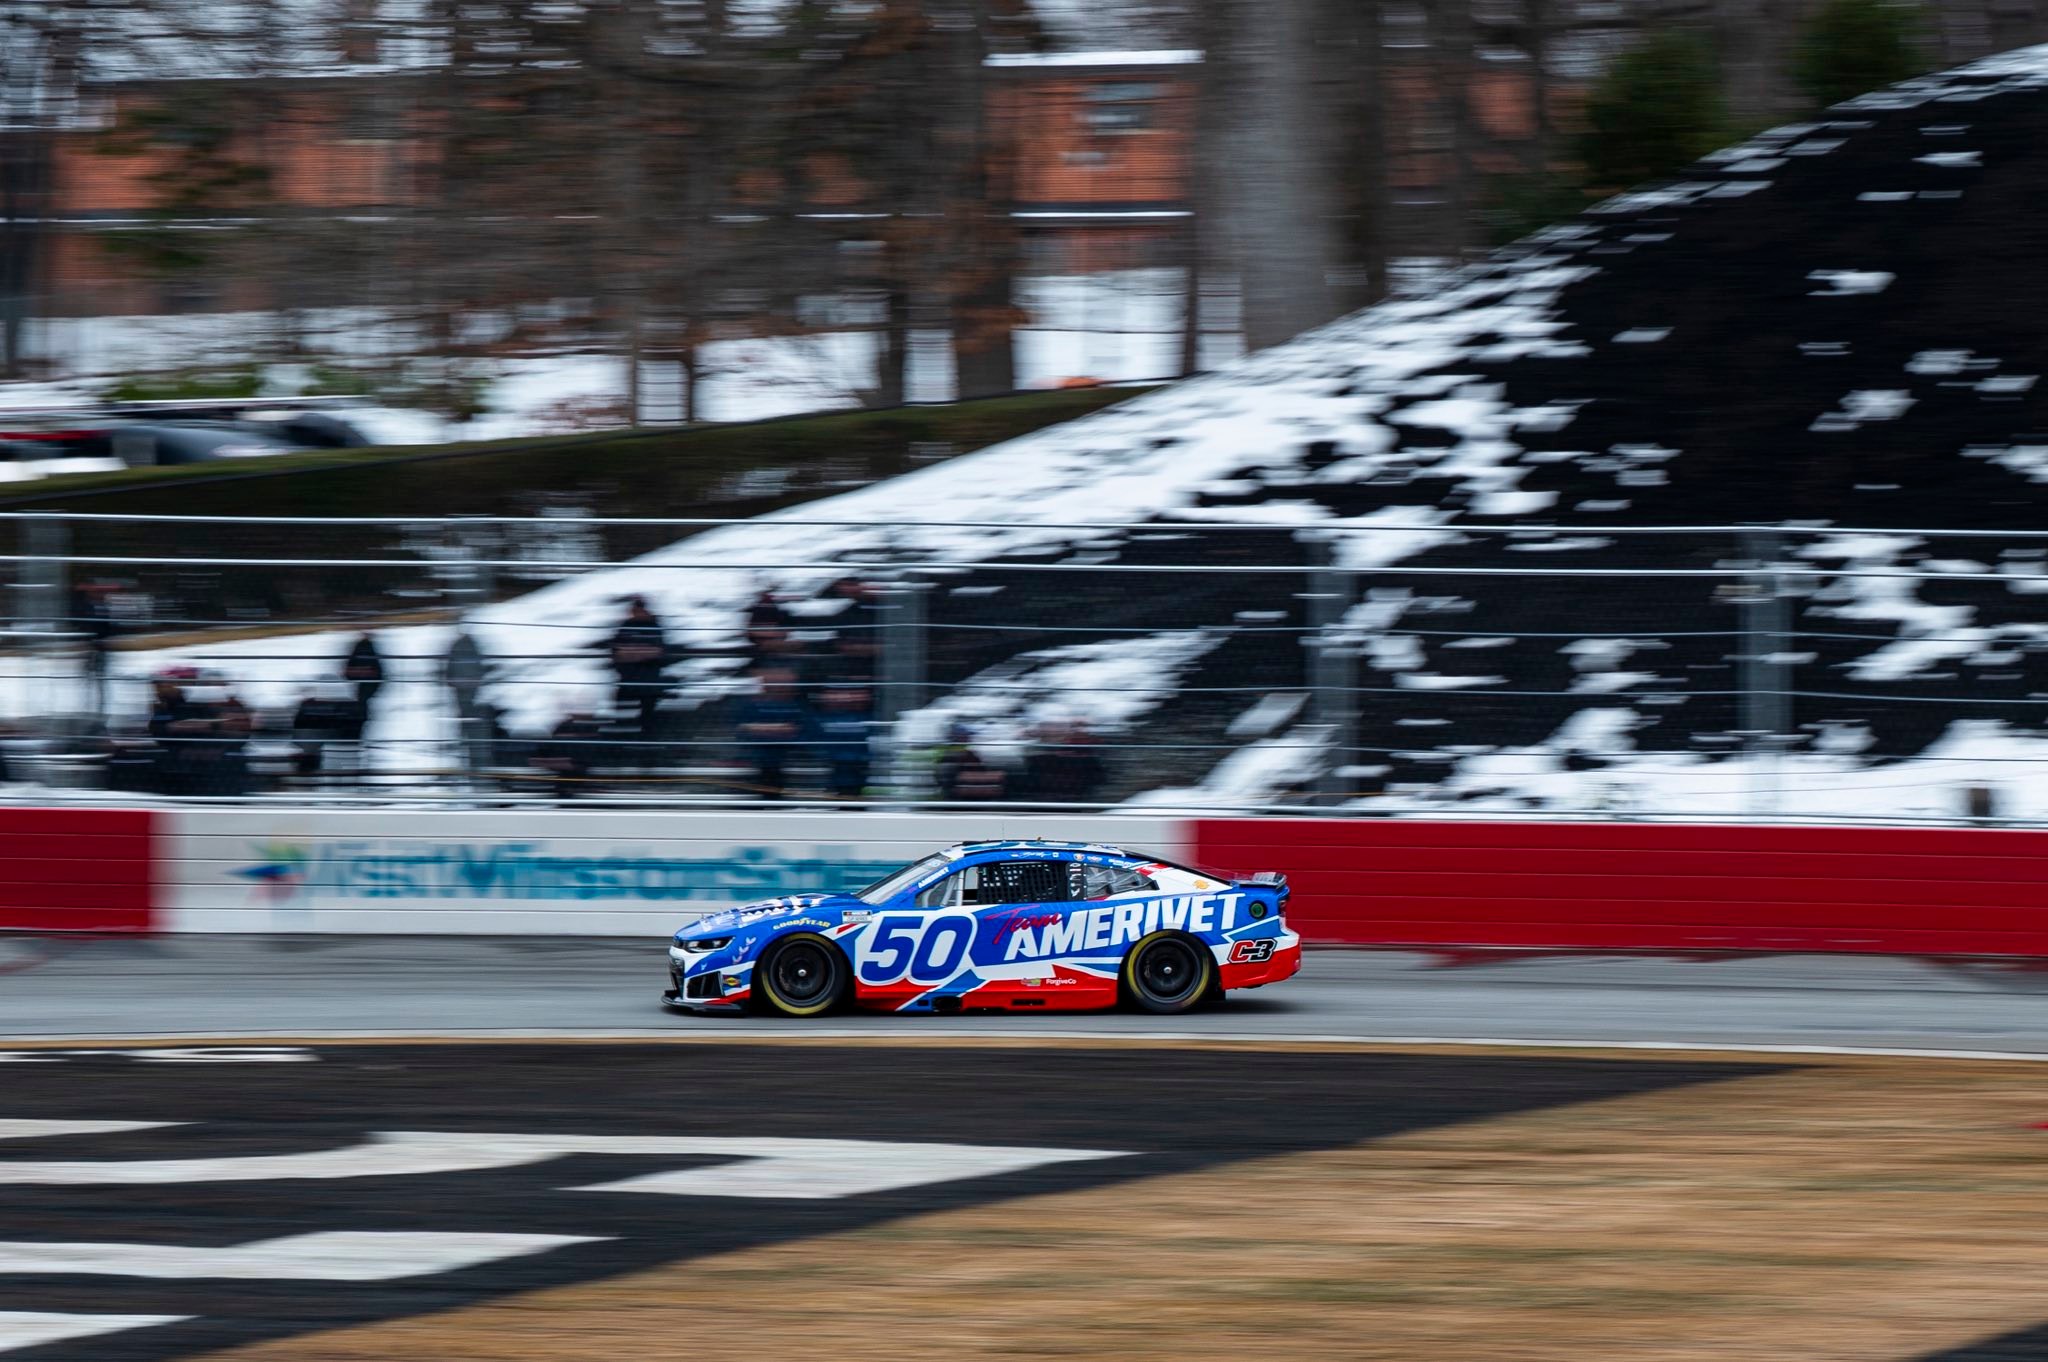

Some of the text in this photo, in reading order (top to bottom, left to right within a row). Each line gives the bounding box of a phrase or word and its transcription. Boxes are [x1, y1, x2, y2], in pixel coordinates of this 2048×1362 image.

[772, 917, 831, 930] GOODYEAR
[985, 904, 1062, 944] Team
[1004, 892, 1246, 961] AMERIVET
[861, 915, 973, 981] 50
[1045, 977, 1077, 986] ForgiveCo
